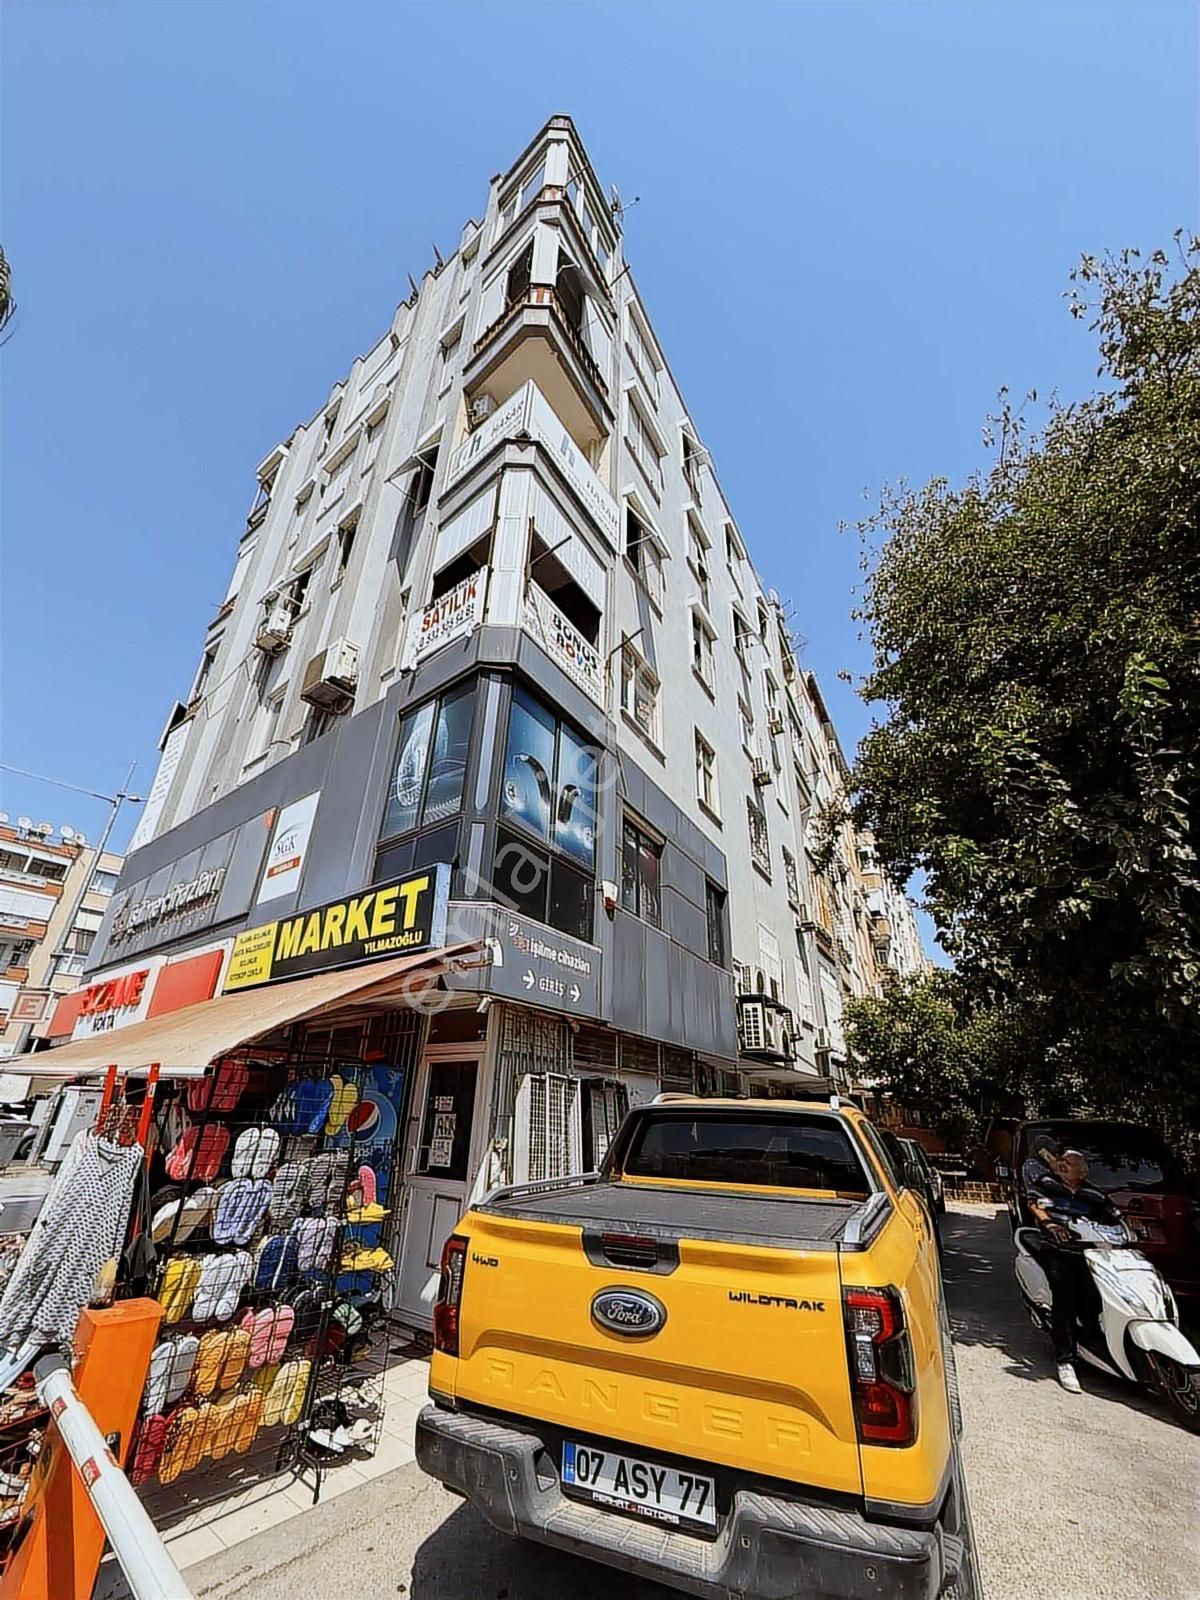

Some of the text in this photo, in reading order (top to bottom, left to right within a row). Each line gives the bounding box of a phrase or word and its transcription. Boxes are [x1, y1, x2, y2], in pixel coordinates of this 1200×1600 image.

[421, 579, 478, 633] SATILIK
[275, 876, 430, 962] MARKET
[363, 930, 424, 956] YILMAZOĞLU
[605, 1298, 647, 1325] Ford
[728, 1290, 826, 1312] WILDTRAK
[482, 1356, 815, 1456] RANGER
[576, 1448, 605, 1486] 07
[613, 1460, 667, 1504] ASY
[678, 1474, 711, 1516] 77
